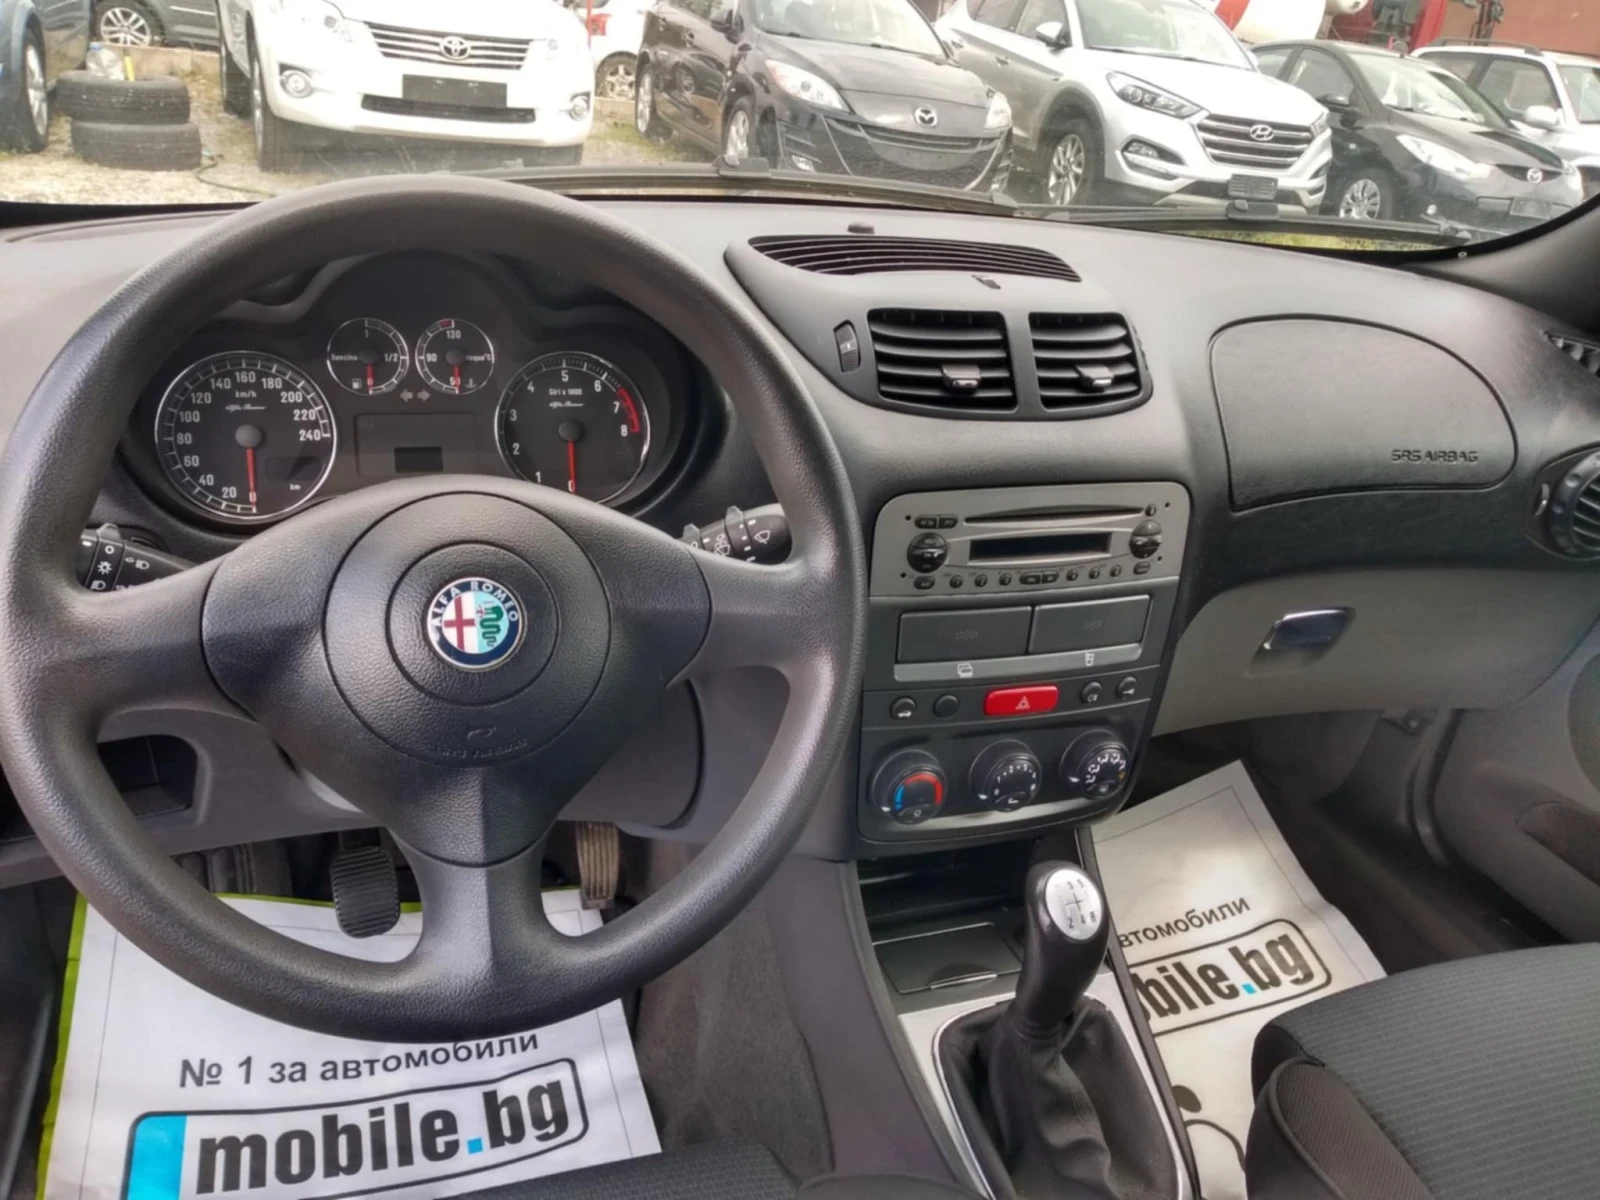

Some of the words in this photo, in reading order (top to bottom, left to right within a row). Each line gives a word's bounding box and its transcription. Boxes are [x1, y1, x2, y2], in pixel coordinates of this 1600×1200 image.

[446, 330, 462, 340] 130
[384, 353, 399, 362] 1/2
[426, 353, 438, 363] 90
[235, 371, 256, 383] 160
[561, 369, 569, 382] 5
[210, 378, 232, 390] 140
[261, 378, 283, 389] 180
[527, 381, 535, 393] 4
[594, 380, 602, 392] 6
[191, 392, 212, 404] 120
[235, 390, 257, 398] km/h
[280, 391, 303, 403] 200
[613, 402, 620, 414] 7
[179, 411, 200, 423] 100
[293, 409, 316, 421] 220
[509, 409, 517, 421] 3
[299, 430, 321, 441] 240
[620, 424, 628, 437] 8
[177, 432, 192, 445] 80
[512, 443, 520, 455] 2
[184, 455, 199, 467] 60
[1391, 449, 1422, 462] SRS
[1424, 449, 1479, 463] AIRBAG
[198, 474, 214, 486] 40
[535, 471, 541, 484] 1
[290, 483, 301, 491] km
[568, 480, 576, 492] 0
[221, 487, 237, 499] 20
[431, 586, 462, 628] ALFA
[470, 580, 519, 622] ROMEO
[1117, 897, 1251, 949] втомобили
[1131, 933, 1315, 1023] bile.bg
[237, 1055, 253, 1085] 1
[268, 1060, 307, 1084] за
[319, 1033, 540, 1081] автомобили
[195, 1079, 570, 1195] mobile.bg
